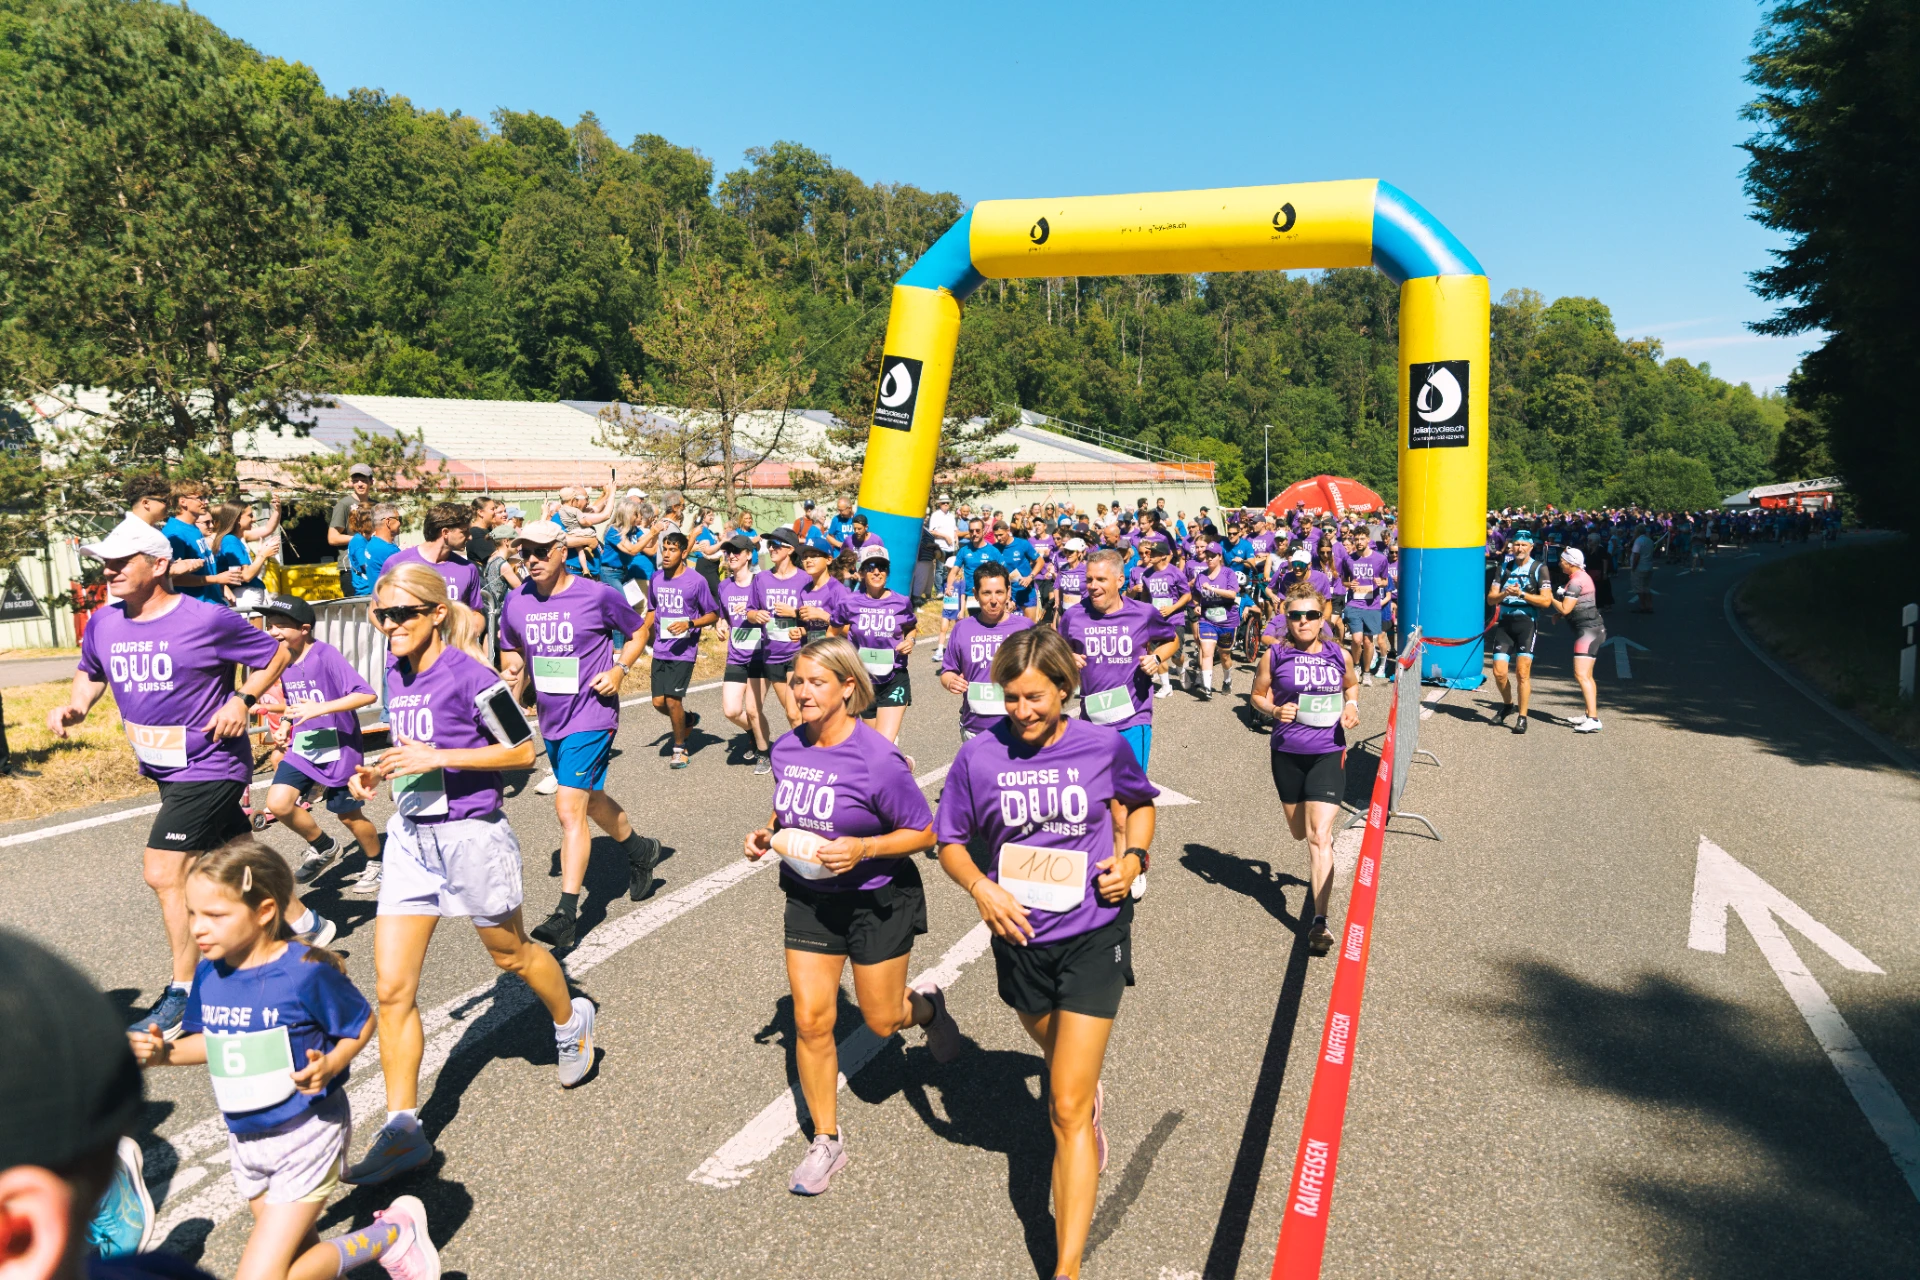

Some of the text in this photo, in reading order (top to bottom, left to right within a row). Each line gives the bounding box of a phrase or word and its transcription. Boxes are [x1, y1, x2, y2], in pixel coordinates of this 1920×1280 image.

[657, 594, 684, 609] DUO
[525, 612, 559, 622] COURSE
[858, 614, 896, 631] DUO
[525, 621, 573, 645] DUO
[971, 634, 1003, 643] COURSE
[1084, 626, 1118, 635] COURSE
[111, 640, 153, 653] COURSE
[547, 644, 574, 653] SUISSE
[971, 643, 1001, 663] DU
[1085, 635, 1132, 656] DUO
[870, 651, 877, 660] 4
[1108, 656, 1132, 664] SUISSE
[1294, 655, 1327, 665] COURSE
[110, 653, 173, 682] DUO
[1294, 665, 1340, 686] DUO
[138, 681, 174, 692] SUISSE
[979, 685, 994, 700] 16
[1098, 692, 1113, 709] 17
[1310, 697, 1333, 712] 64
[389, 708, 434, 742] DUO
[133, 726, 170, 748] 107
[784, 764, 824, 782] COURSE
[997, 769, 1059, 787] COURSE
[775, 779, 835, 820] DUO
[1000, 785, 1088, 827] DUO
[798, 817, 834, 832] SUISSE
[1042, 822, 1087, 836] SUISSE
[165, 831, 187, 841] JAKO
[1019, 852, 1073, 882] 110
[1358, 855, 1374, 887] RAIFFEISEN
[1344, 922, 1365, 962] RAIFFEISEN
[1324, 1011, 1351, 1065] RAIFFEISEN
[222, 1040, 246, 1076] 6
[1294, 1138, 1329, 1217] RAIFFEISEN
